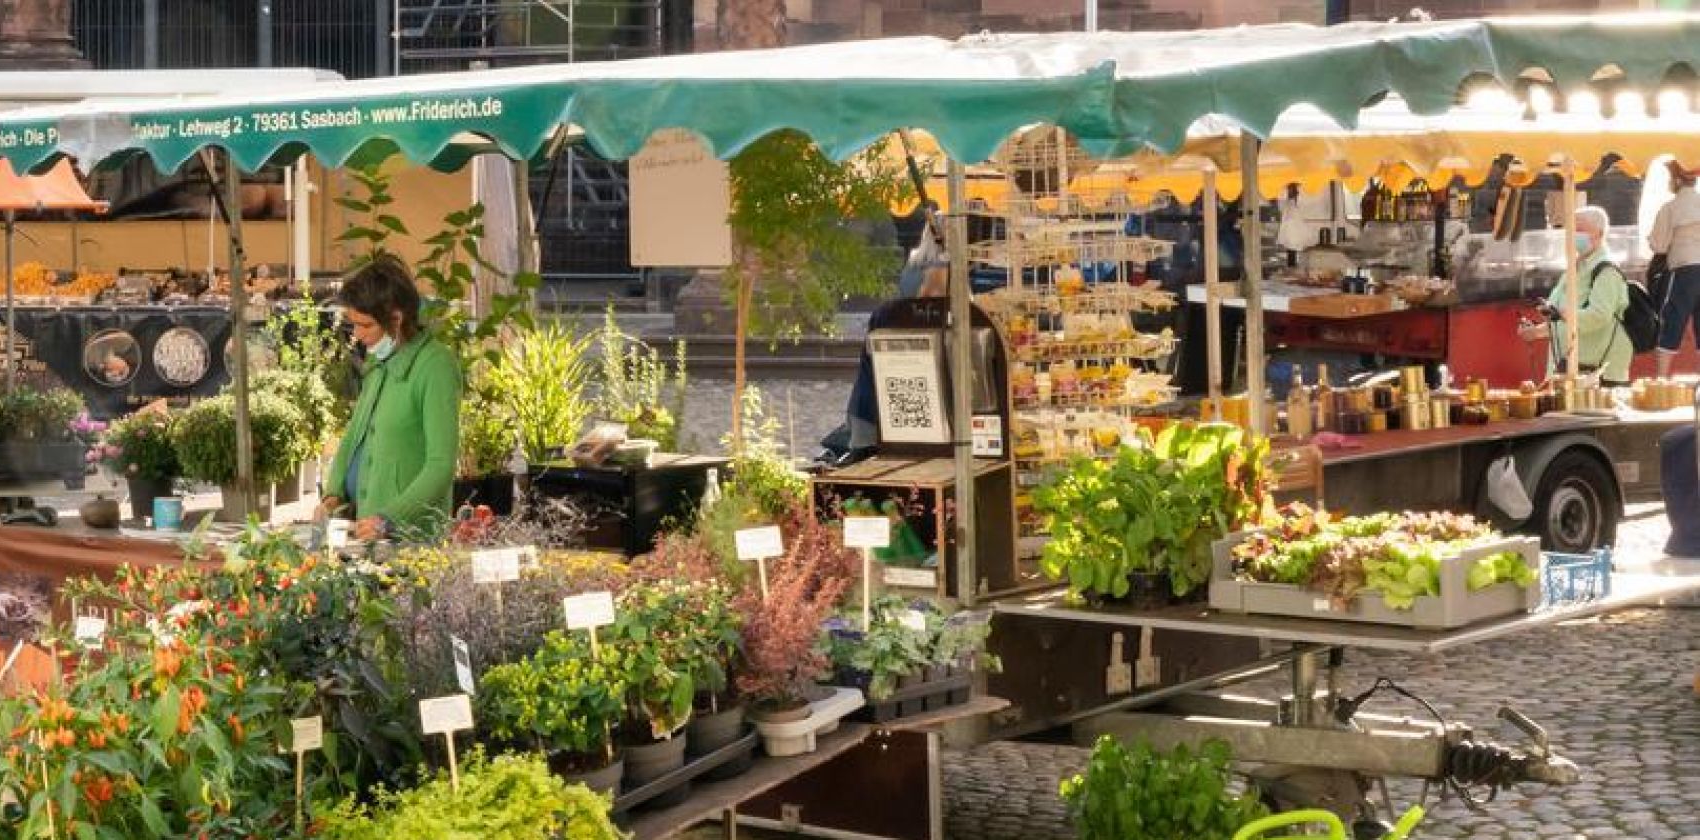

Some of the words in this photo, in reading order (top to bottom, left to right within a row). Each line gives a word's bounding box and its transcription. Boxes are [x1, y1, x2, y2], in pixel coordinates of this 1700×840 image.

[23, 127, 45, 146] Die
[179, 118, 230, 137] Lehweg
[233, 115, 243, 134] 2
[251, 111, 298, 132] 79361
[301, 107, 360, 129] Sasbach
[371, 97, 502, 123] www.Friderich.de
